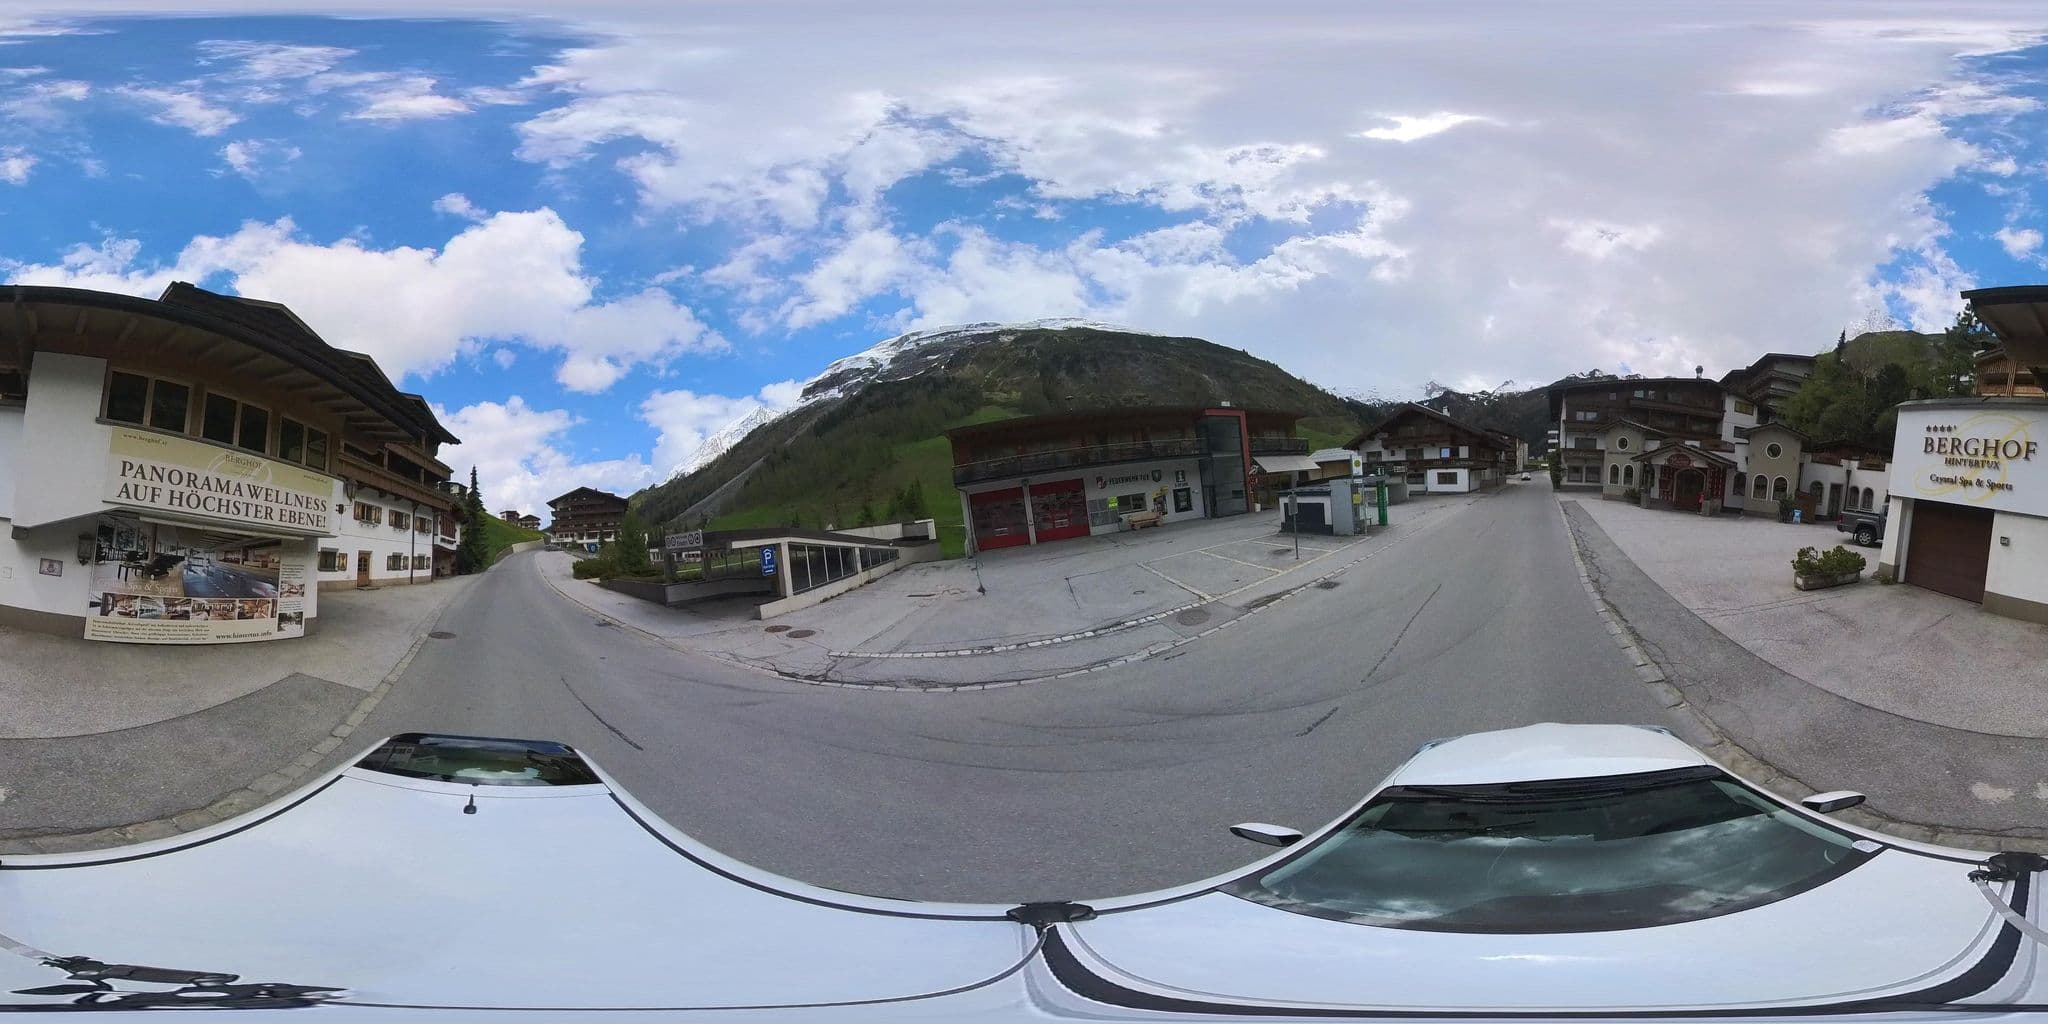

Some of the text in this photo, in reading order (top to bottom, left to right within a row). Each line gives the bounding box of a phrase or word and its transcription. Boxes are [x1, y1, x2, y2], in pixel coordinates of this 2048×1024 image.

[1923, 436, 2038, 461] BERGHOF
[225, 454, 263, 469] BERGHOF
[1944, 457, 2000, 470] HINTERTUX
[1929, 473, 2013, 492] Crystal Spa & Sports
[116, 482, 327, 528] AUF HÖCHSTER EBENE!
